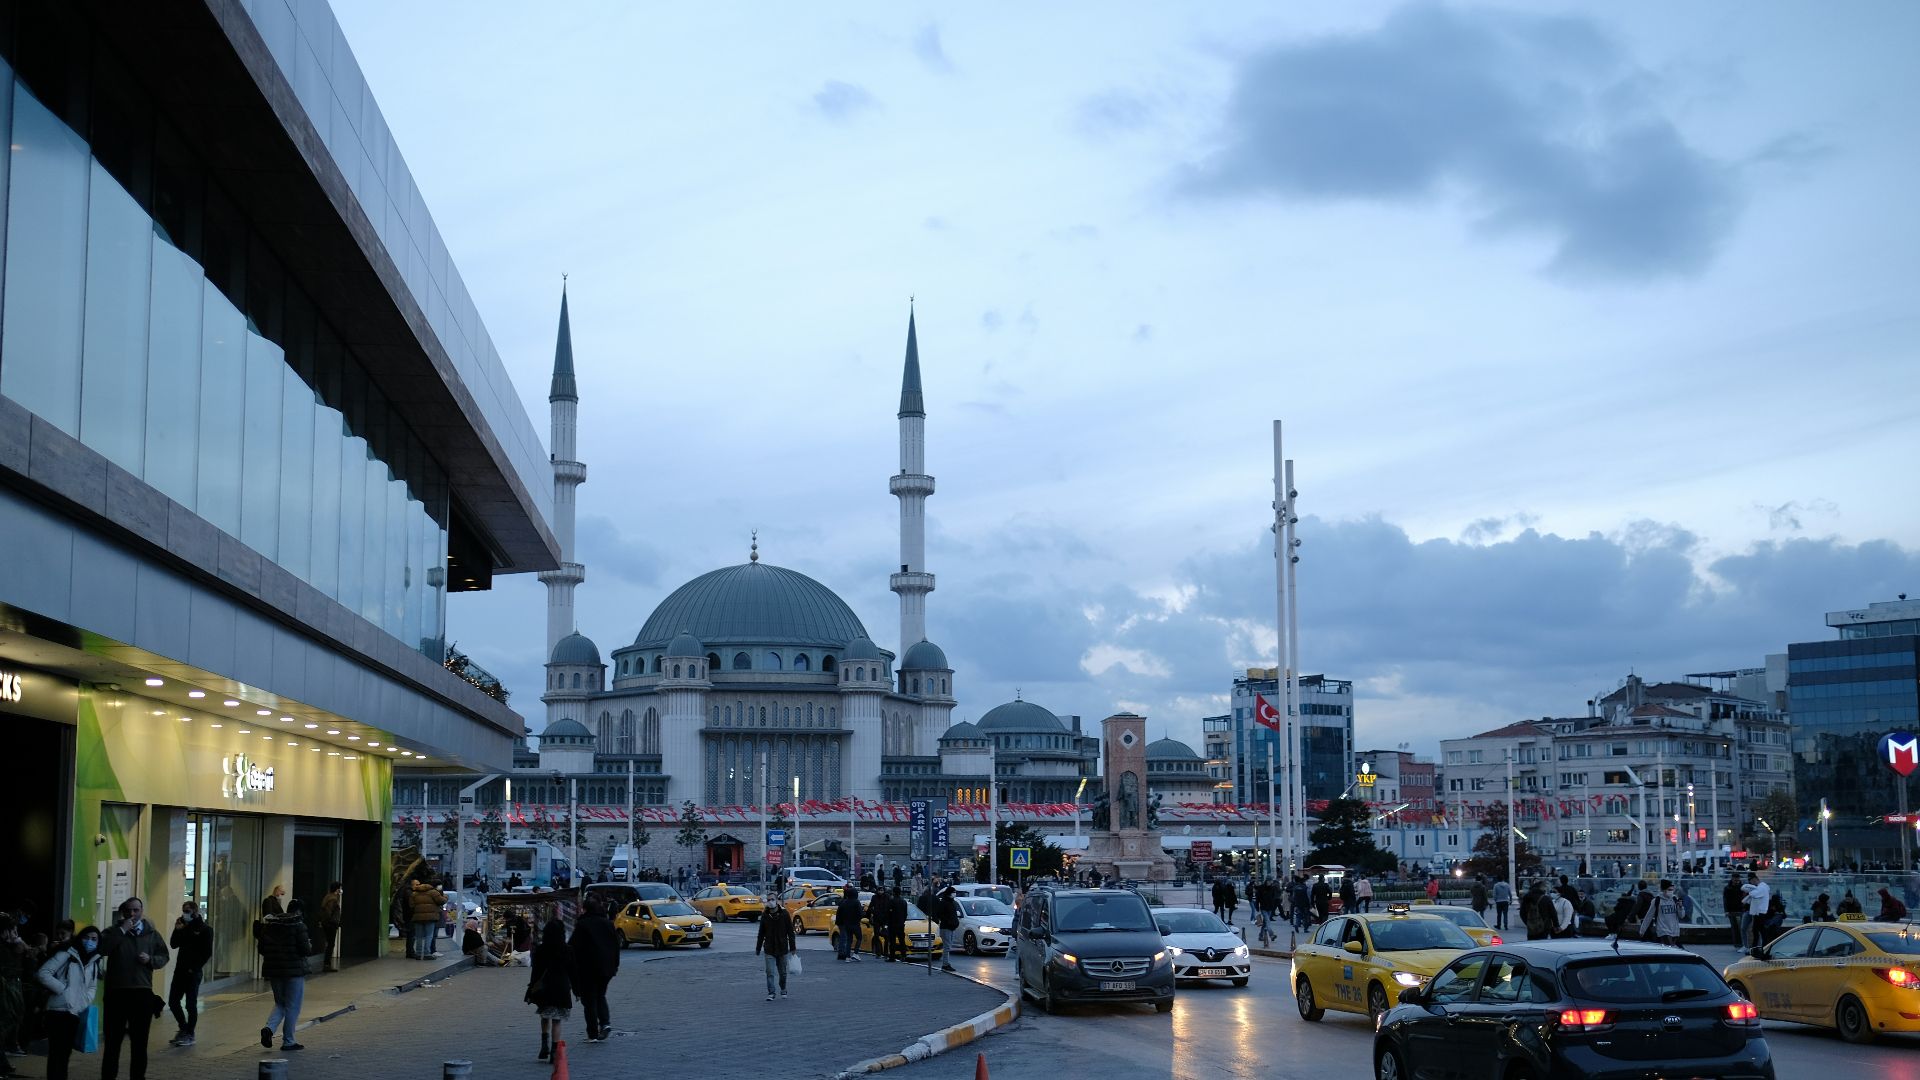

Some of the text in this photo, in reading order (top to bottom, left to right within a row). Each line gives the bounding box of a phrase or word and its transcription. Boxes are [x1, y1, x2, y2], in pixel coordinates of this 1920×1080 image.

[0, 671, 22, 702] KS
[1889, 738, 1919, 763] M
[1356, 774, 1377, 783] YKP
[917, 807, 926, 831] PARK
[938, 823, 947, 847] PARK
